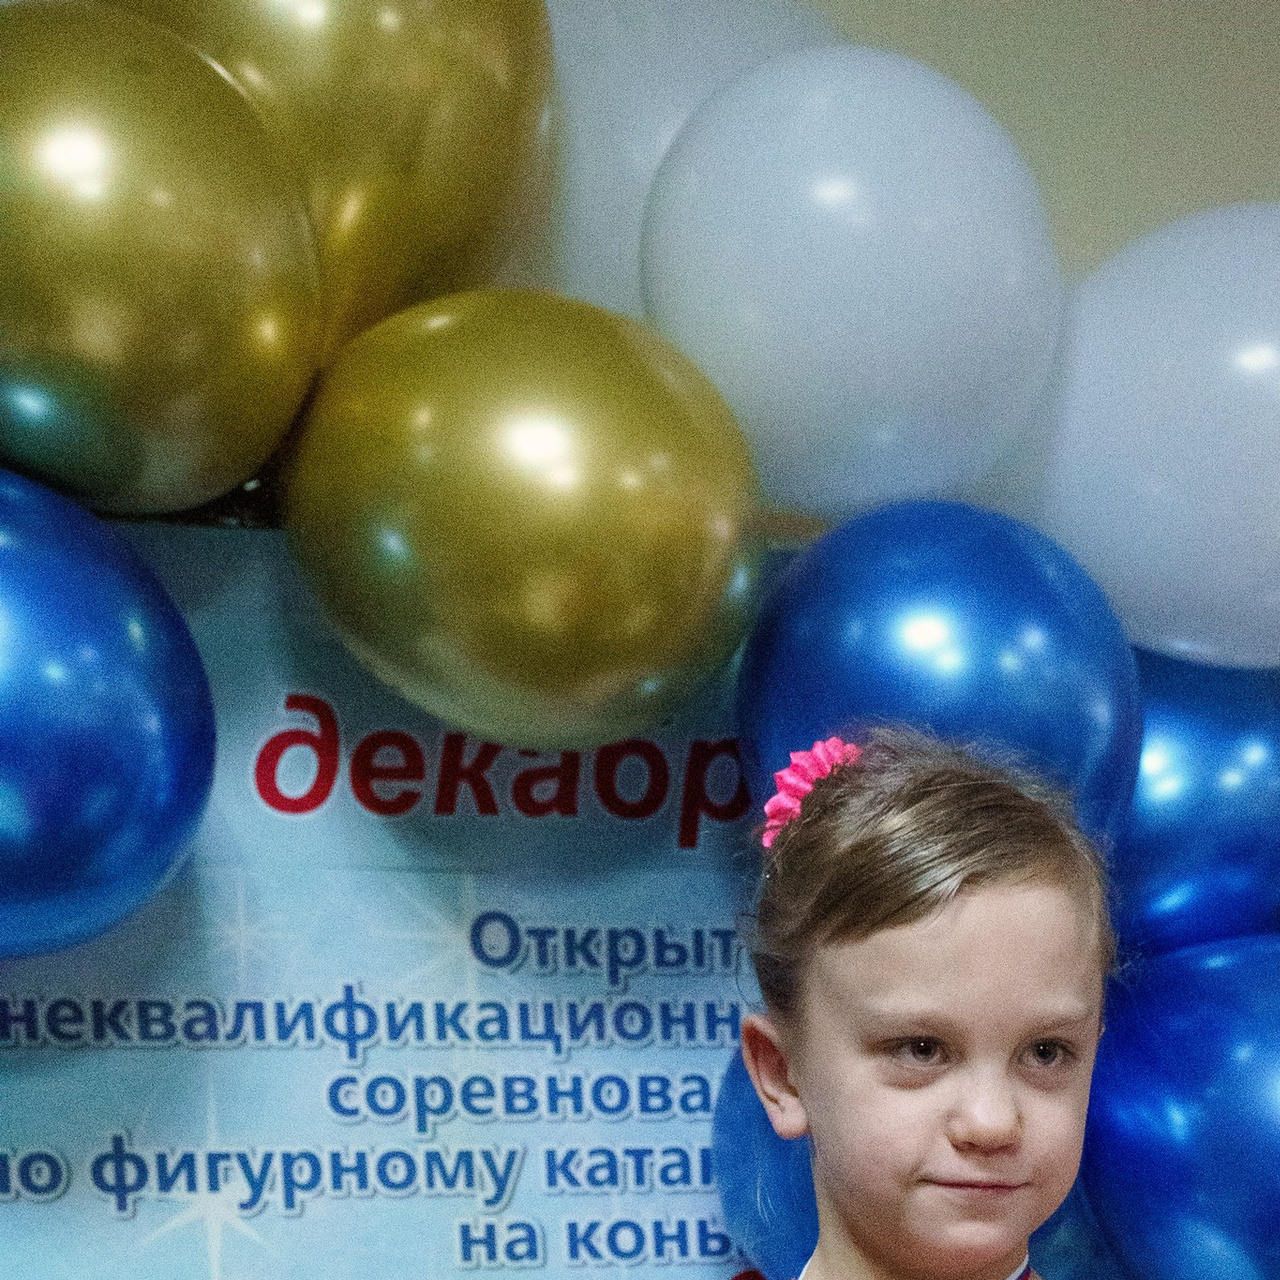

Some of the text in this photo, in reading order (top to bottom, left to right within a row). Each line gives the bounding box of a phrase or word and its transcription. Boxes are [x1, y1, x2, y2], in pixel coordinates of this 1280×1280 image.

[469, 910, 738, 987] Открыт
[0, 984, 742, 1059] неквалификационн
[328, 1073, 712, 1134] соревнова
[91, 1135, 520, 1212] фигурному
[459, 1219, 742, 1262] на конь
